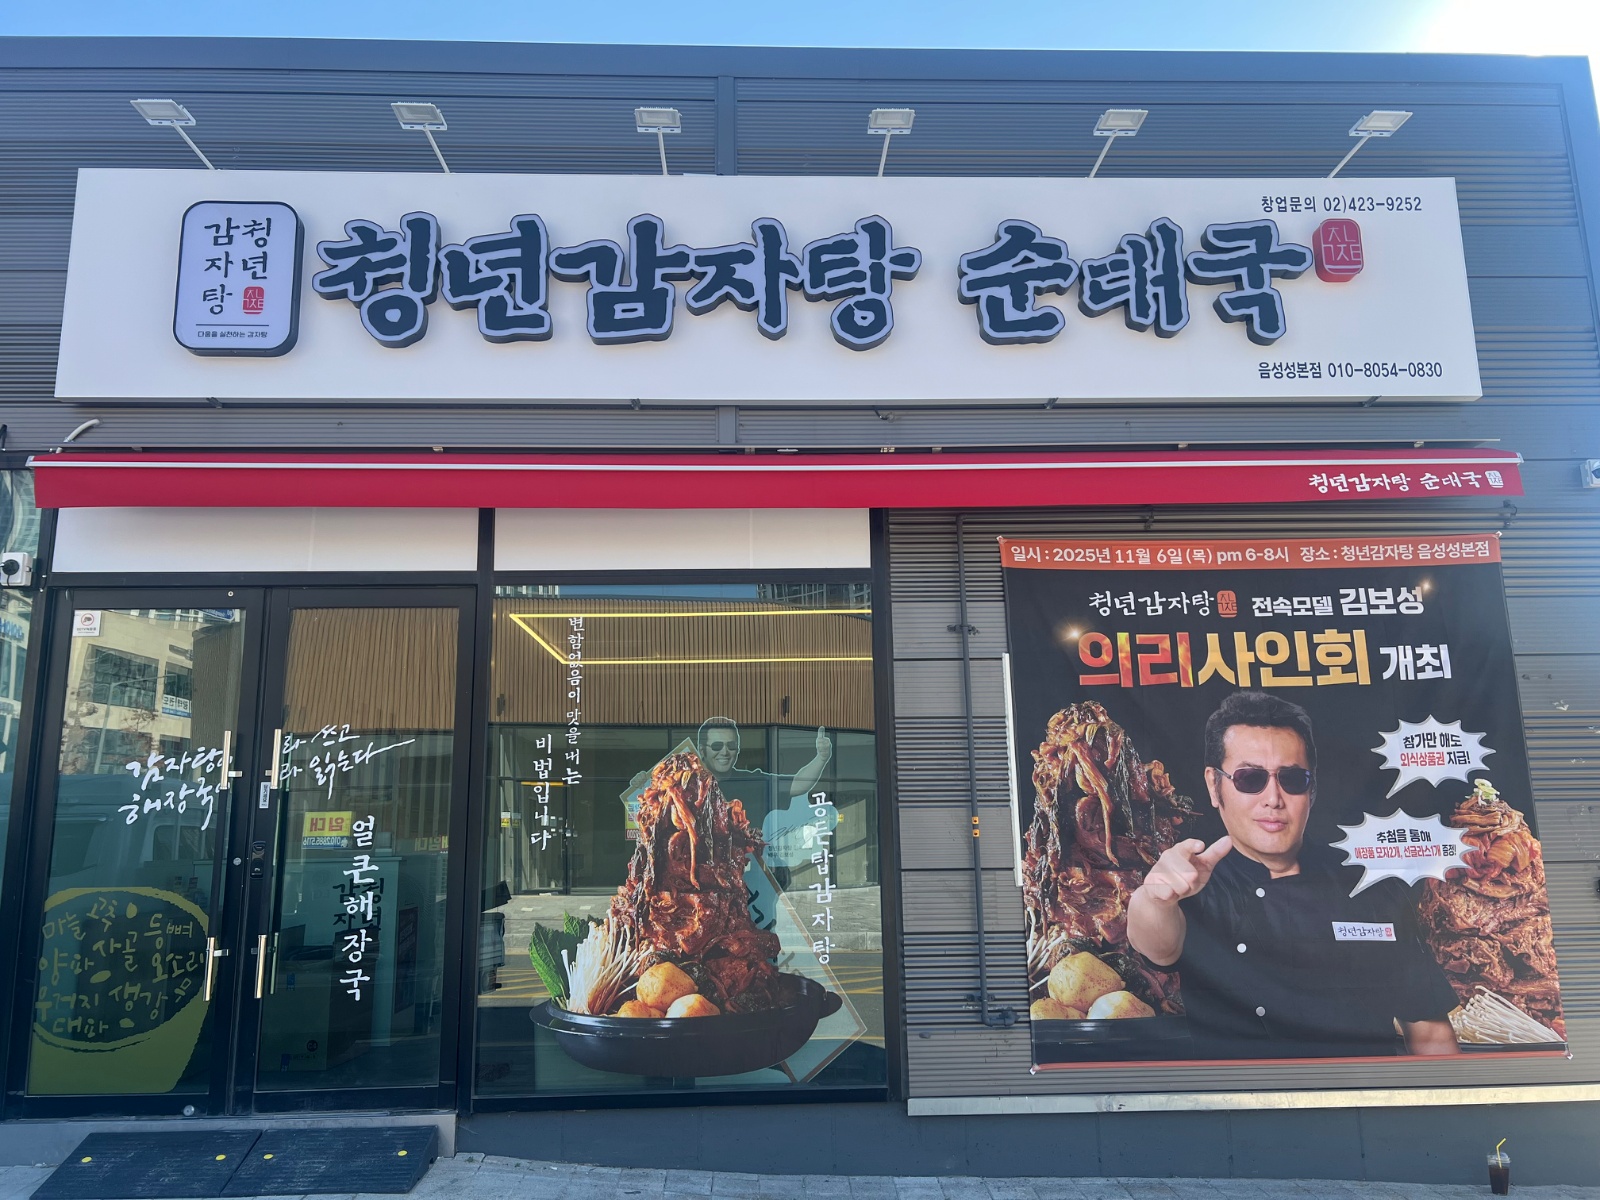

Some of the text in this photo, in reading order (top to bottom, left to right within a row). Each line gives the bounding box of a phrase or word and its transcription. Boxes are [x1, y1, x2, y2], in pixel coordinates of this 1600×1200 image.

[1261, 195, 1423, 213] 창업문의 02)423-9252
[202, 216, 241, 316] 감자탕
[241, 217, 272, 280] 청년
[311, 211, 1314, 351] 청년감자탕 순대국
[247, 330, 268, 339] 감자탕
[1258, 361, 1443, 379] 음성성본점 010-8054-0830
[1308, 471, 1482, 494] 청년감자탕 순대국
[1053, 547, 1111, 564] 2025년
[1115, 548, 1151, 564] 11월
[1216, 550, 1242, 564] pm
[1245, 547, 1289, 562] 6-8시
[1340, 544, 1413, 561] 청년감자탕
[1417, 540, 1490, 559] 음성성본점
[1088, 586, 1425, 617] 청년감자탕 전속모델 김보성
[1078, 629, 1452, 688] 의리사인회 개최
[310, 723, 361, 747] 쓰고
[565, 708, 582, 745] 맛을
[1403, 732, 1463, 749] 참가만 해도
[309, 739, 416, 800] 읽는다
[561, 748, 583, 785] 내는
[1400, 751, 1471, 767] 외식상품권 지급!
[530, 733, 553, 851] 비법입니다
[1354, 844, 1457, 860] 애장품 모자2개, 선글라스1개 증정!
[1376, 828, 1432, 843] 추첨을 통해
[808, 791, 837, 965] 공든탑감자탕
[42, 911, 86, 940] 마늘
[86, 896, 118, 932] 고추
[338, 814, 379, 1002] 얼큰해장국
[143, 913, 193, 949] 등뼈
[1337, 926, 1385, 938] 청년감자탕
[38, 947, 94, 986] 양파
[92, 931, 138, 972] 사골
[35, 985, 99, 1022] 우거지
[108, 981, 169, 1020] 생강
[52, 1015, 109, 1038] 대파
